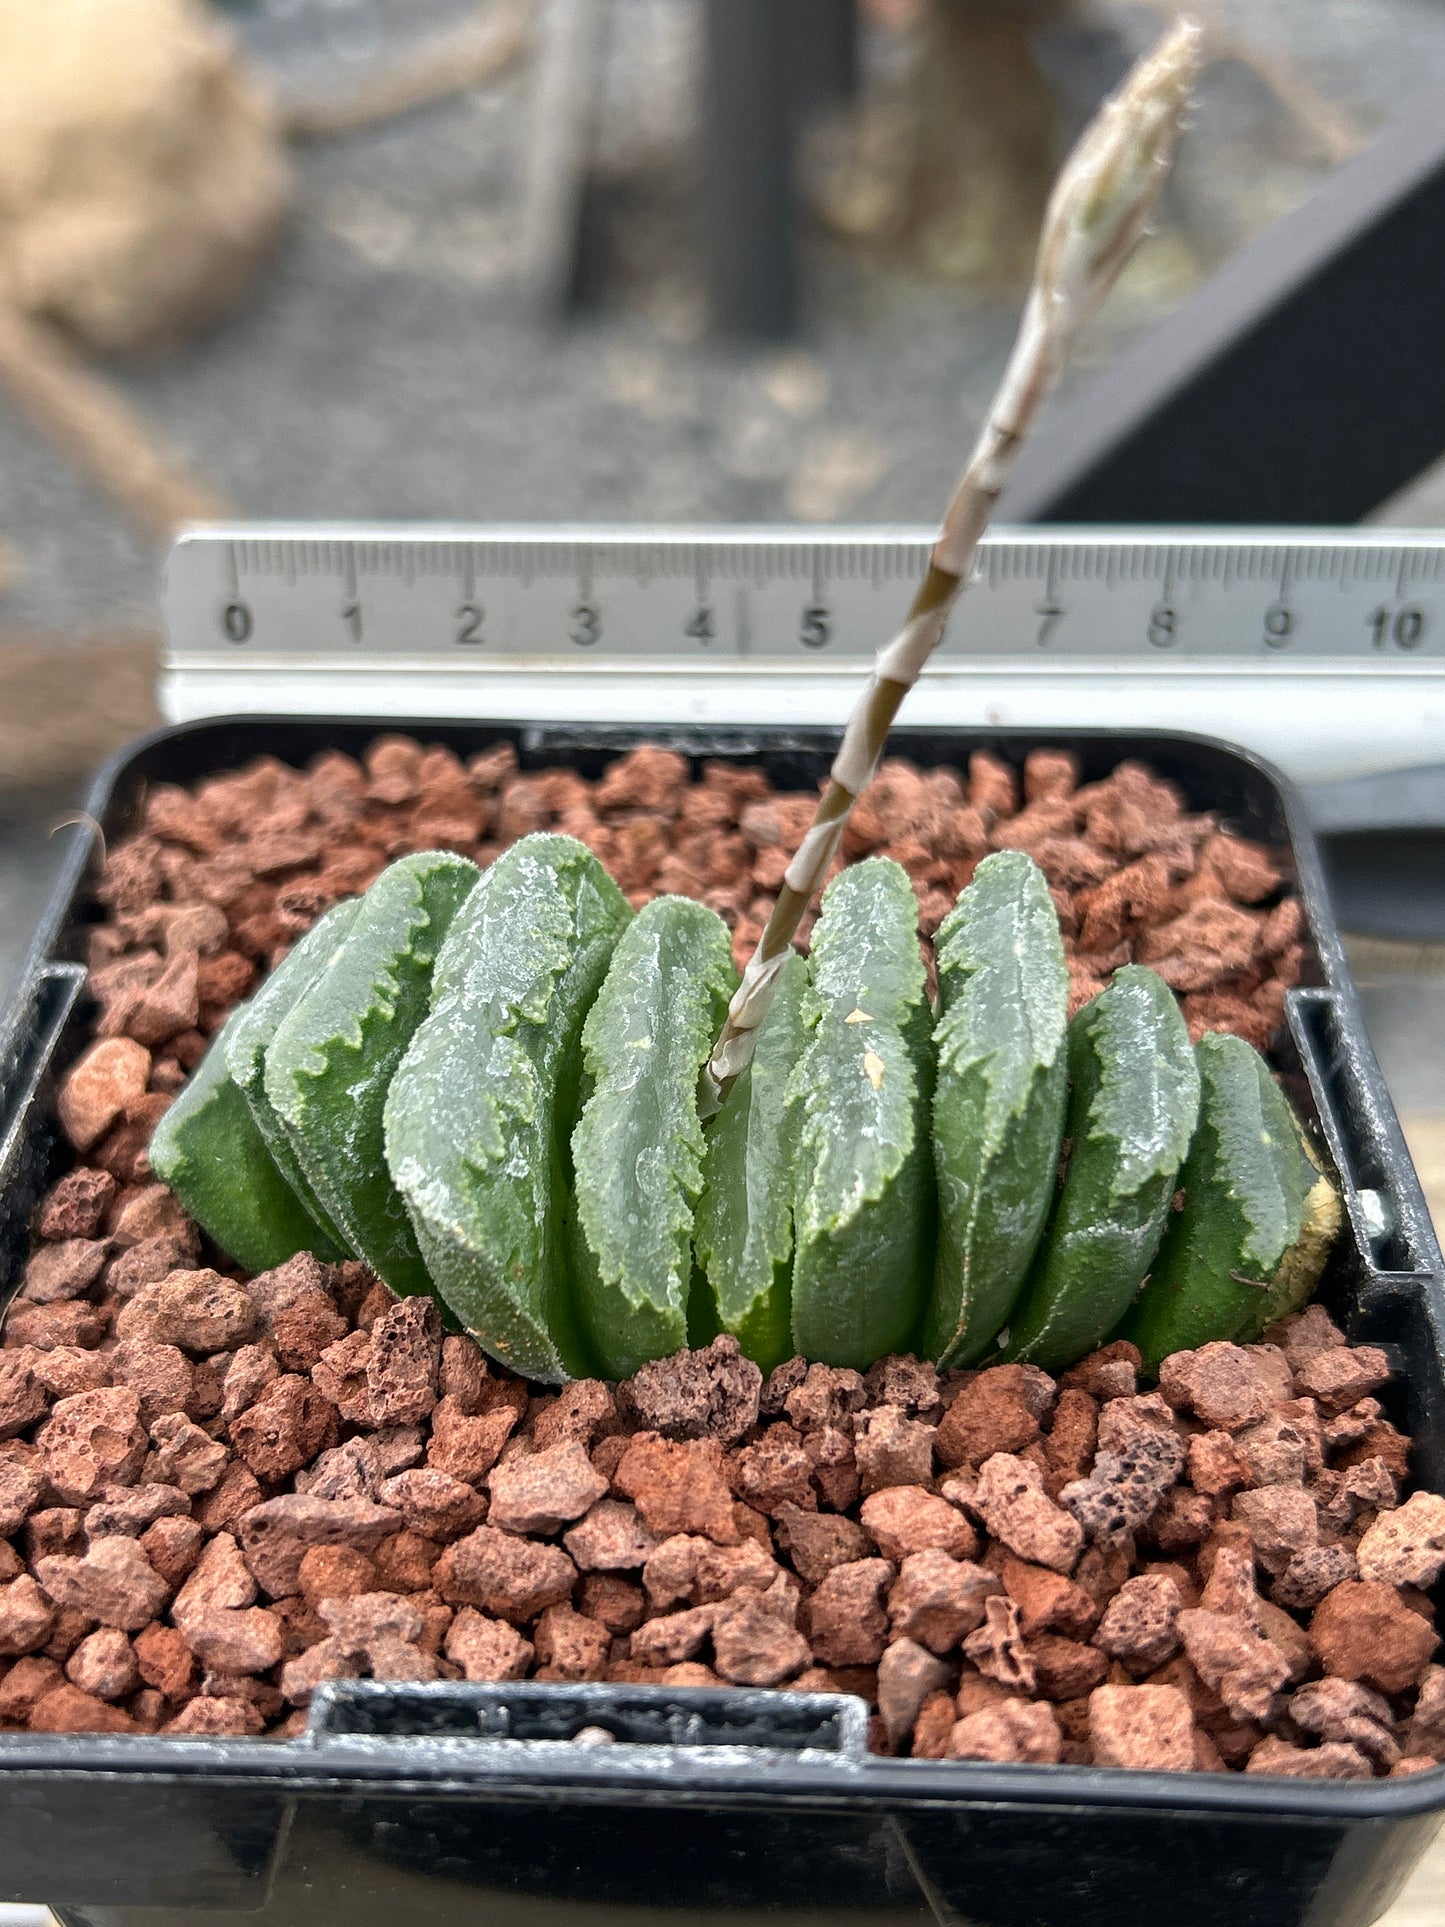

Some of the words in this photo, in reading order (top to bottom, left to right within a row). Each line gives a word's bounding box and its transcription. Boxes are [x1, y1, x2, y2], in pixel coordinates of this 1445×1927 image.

[222, 603, 253, 643] 0
[342, 604, 363, 644] 1
[455, 606, 485, 645] 2
[570, 605, 601, 646] 3
[684, 607, 714, 647] 4
[800, 607, 831, 648] 5
[1034, 605, 1065, 647] 7
[1147, 608, 1177, 648] 8
[1262, 606, 1294, 648] 9
[1368, 607, 1425, 650] 10
